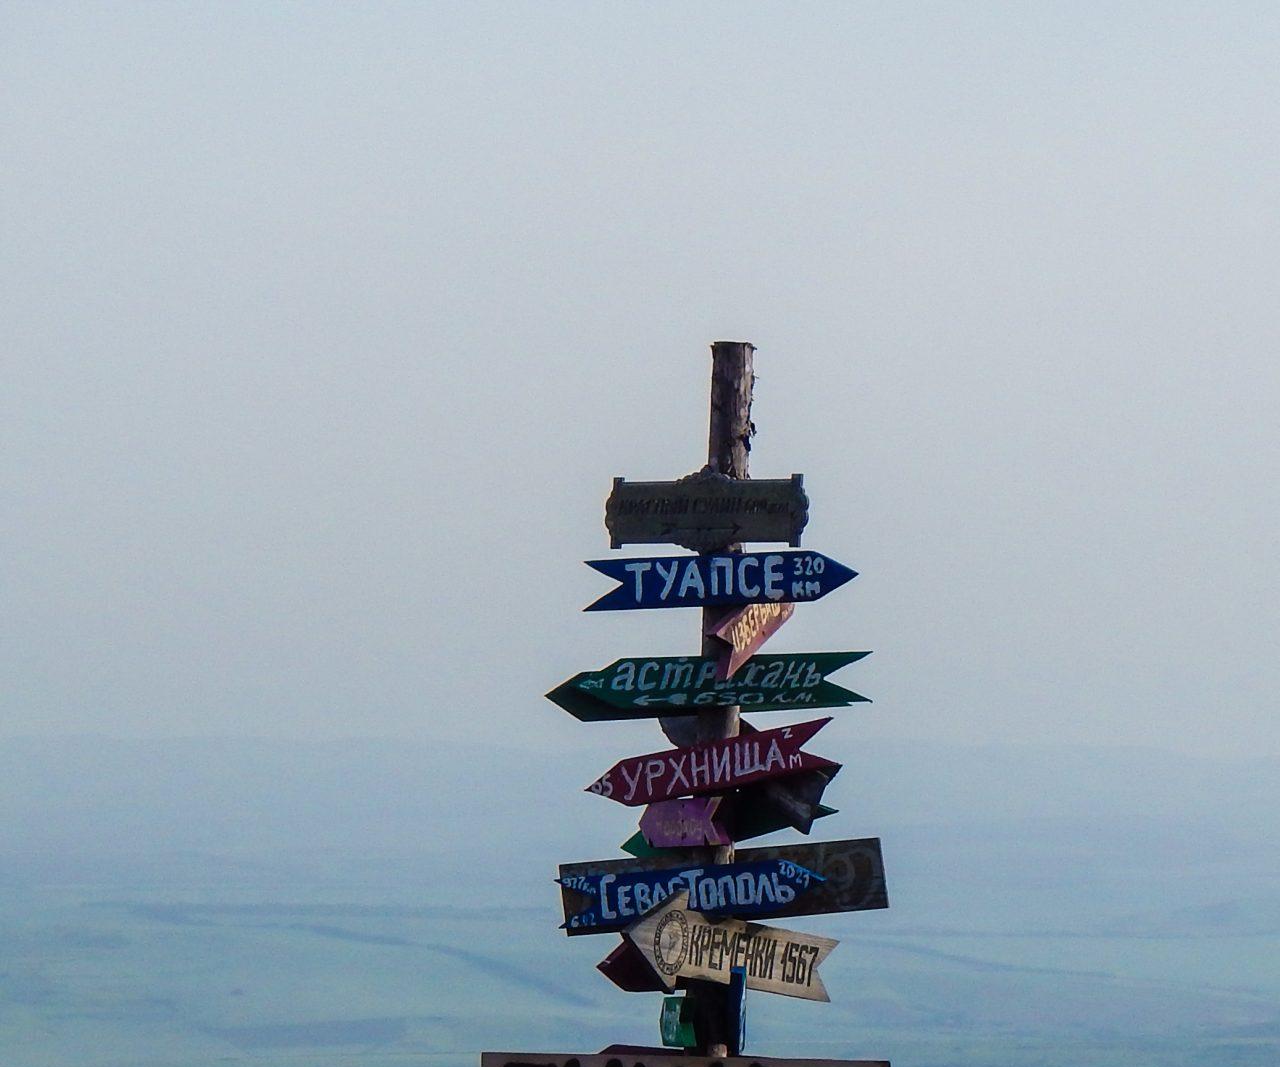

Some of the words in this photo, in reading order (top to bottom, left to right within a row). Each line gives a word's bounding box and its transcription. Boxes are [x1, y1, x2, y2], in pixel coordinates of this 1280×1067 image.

[625, 555, 785, 603] ТУАПСЕ
[793, 557, 825, 576] 320
[621, 739, 785, 801] УРХНИЩА
[689, 925, 776, 978] КРЕМЕНКИ
[781, 942, 819, 987] 1567
